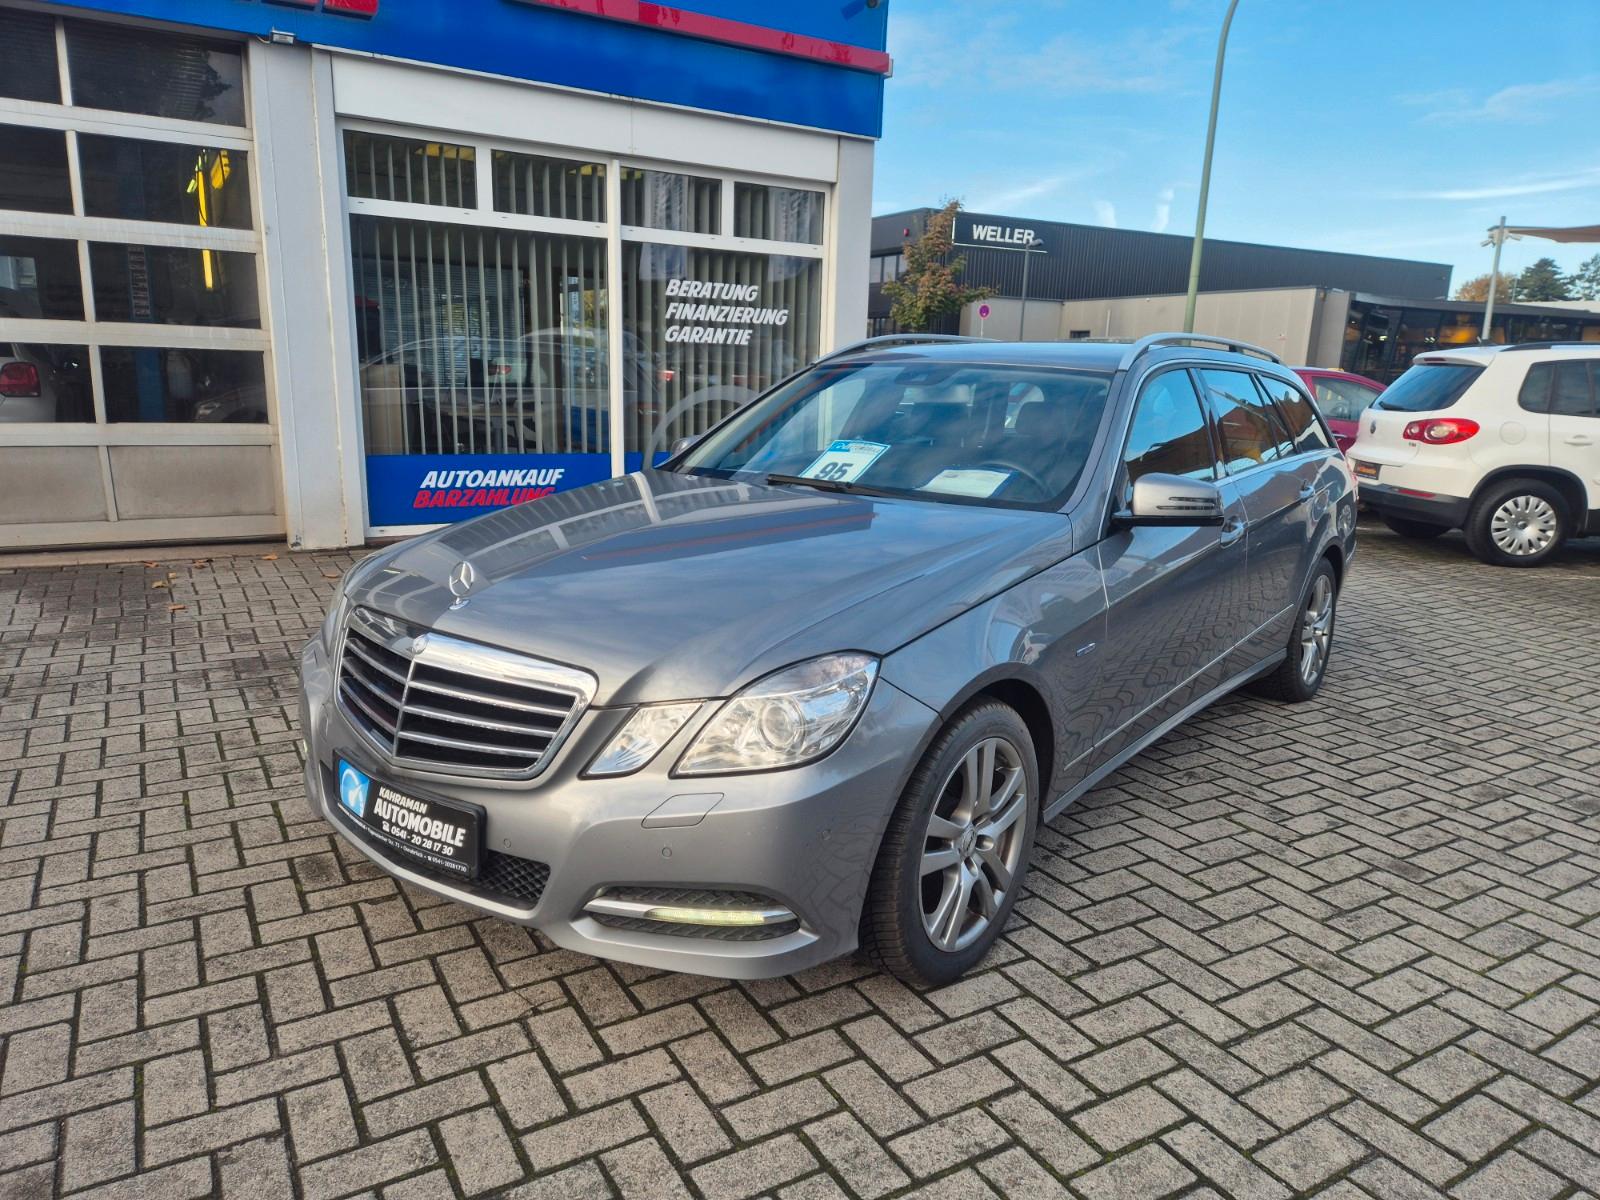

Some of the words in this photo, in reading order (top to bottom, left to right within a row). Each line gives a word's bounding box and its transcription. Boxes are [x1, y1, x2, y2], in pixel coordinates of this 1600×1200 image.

[973, 224, 1035, 244] WELLER
[665, 279, 759, 301] BERATUNG
[665, 303, 789, 325] FINANZIERUNG
[665, 325, 753, 345] GARANTIE
[420, 469, 565, 488] AUTOANKAUF
[814, 462, 853, 480] 95
[379, 786, 428, 814] KAHRAMAN
[374, 798, 466, 847] AUTOMOBILE
[391, 825, 407, 839] 0541
[411, 834, 421, 845] 20
[422, 839, 432, 849] 28
[433, 842, 442, 852] 17
[442, 845, 454, 856] 30
